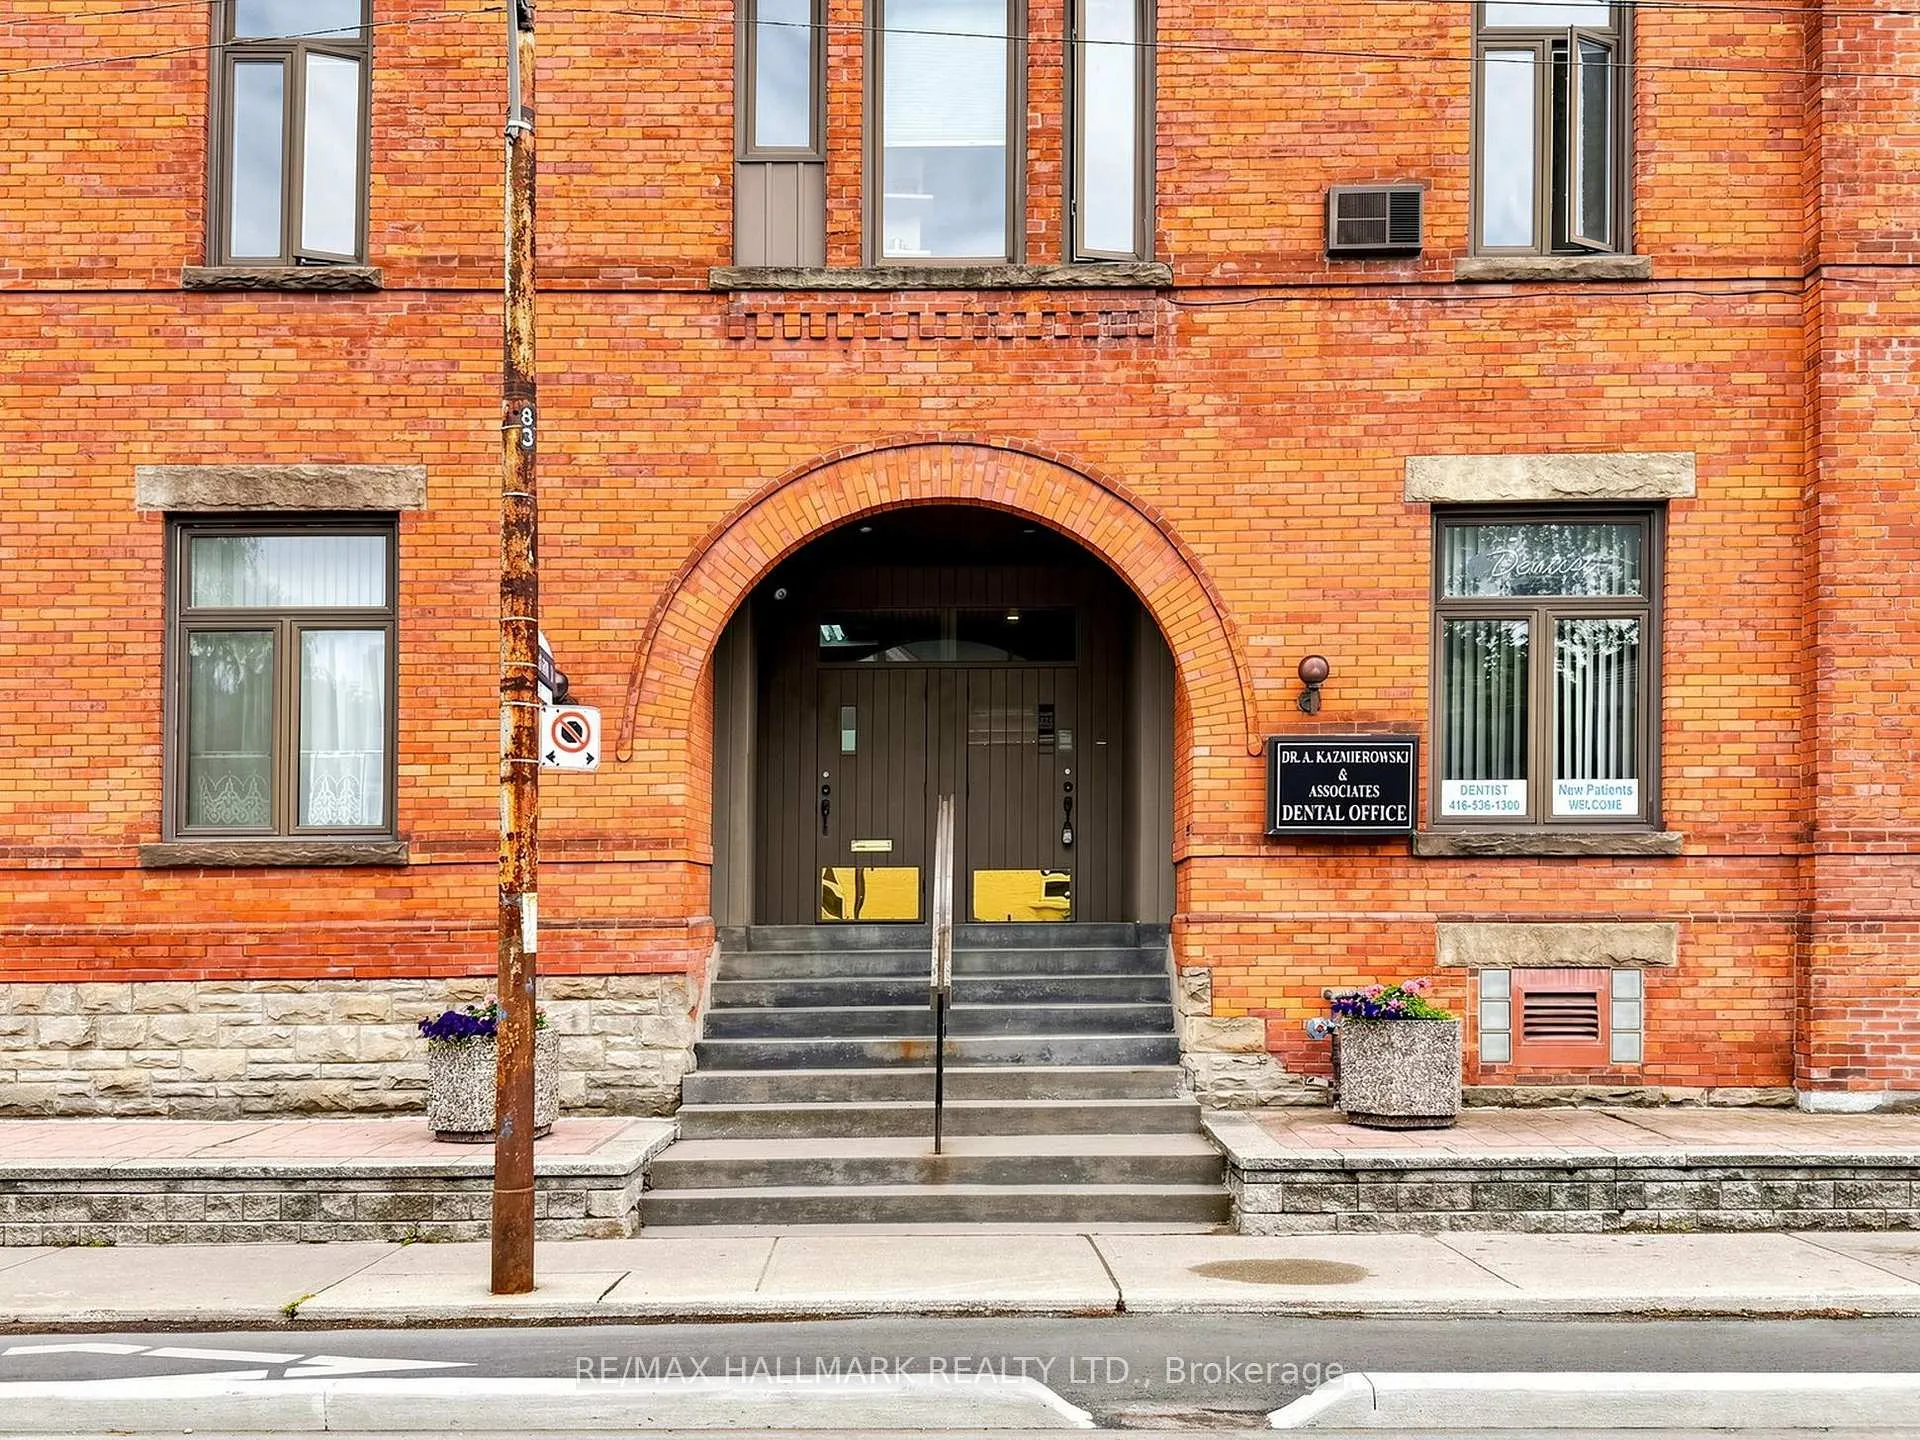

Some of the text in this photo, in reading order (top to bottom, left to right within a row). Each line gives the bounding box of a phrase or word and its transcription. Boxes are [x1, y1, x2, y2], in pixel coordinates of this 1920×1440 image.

[1487, 549, 1606, 578] Dentist
[1282, 751, 1409, 763] DR. A. KAZMIEROWSKI
[1338, 768, 1348, 781] &
[1309, 785, 1380, 798] ASSOCIATES
[1460, 784, 1508, 796] DENTIST
[1558, 784, 1633, 796] New Patients
[1569, 799, 1622, 811] WELCOME
[1282, 804, 1407, 821] DENTAL OFFICE
